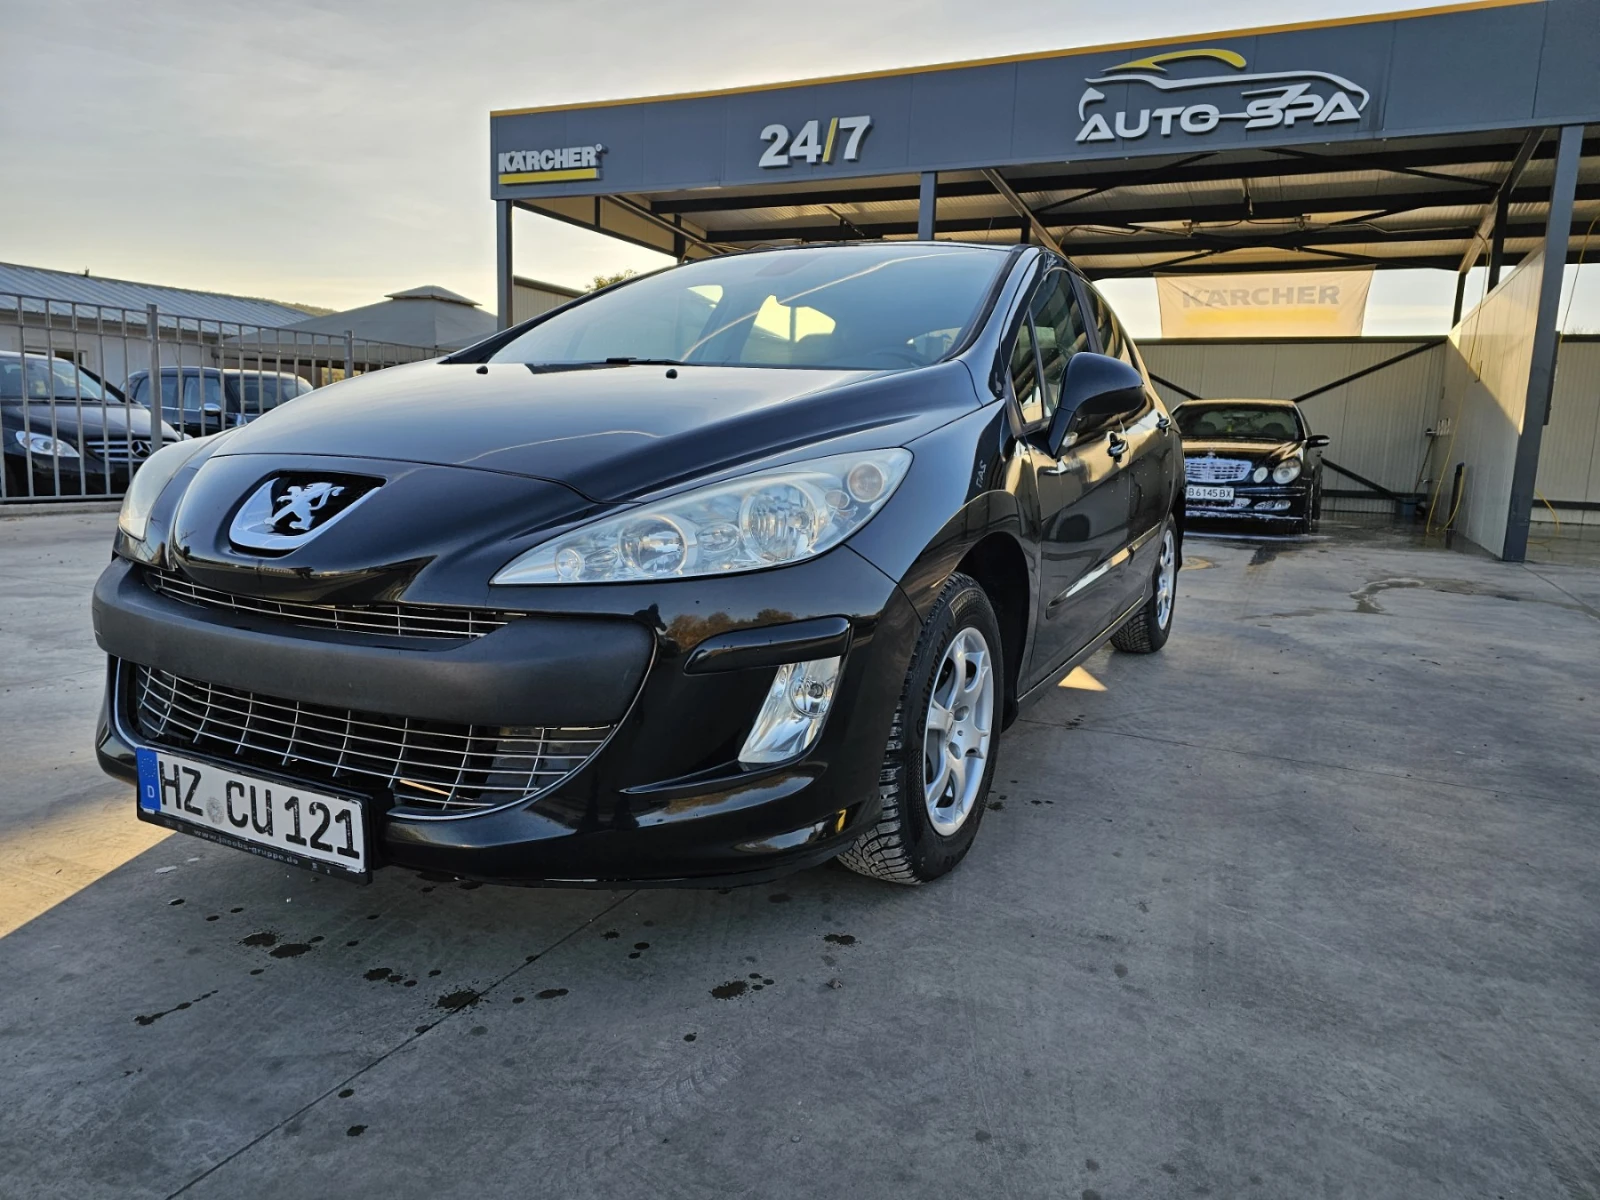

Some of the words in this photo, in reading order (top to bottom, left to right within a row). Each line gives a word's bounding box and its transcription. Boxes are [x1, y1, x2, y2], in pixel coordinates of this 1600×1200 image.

[1074, 104, 1220, 142] AUTO
[1242, 83, 1362, 130] SPA
[758, 115, 872, 168] 24/7
[147, 785, 155, 798] D
[159, 760, 203, 817] HZ
[226, 780, 273, 836] CU
[284, 795, 360, 860] 121
